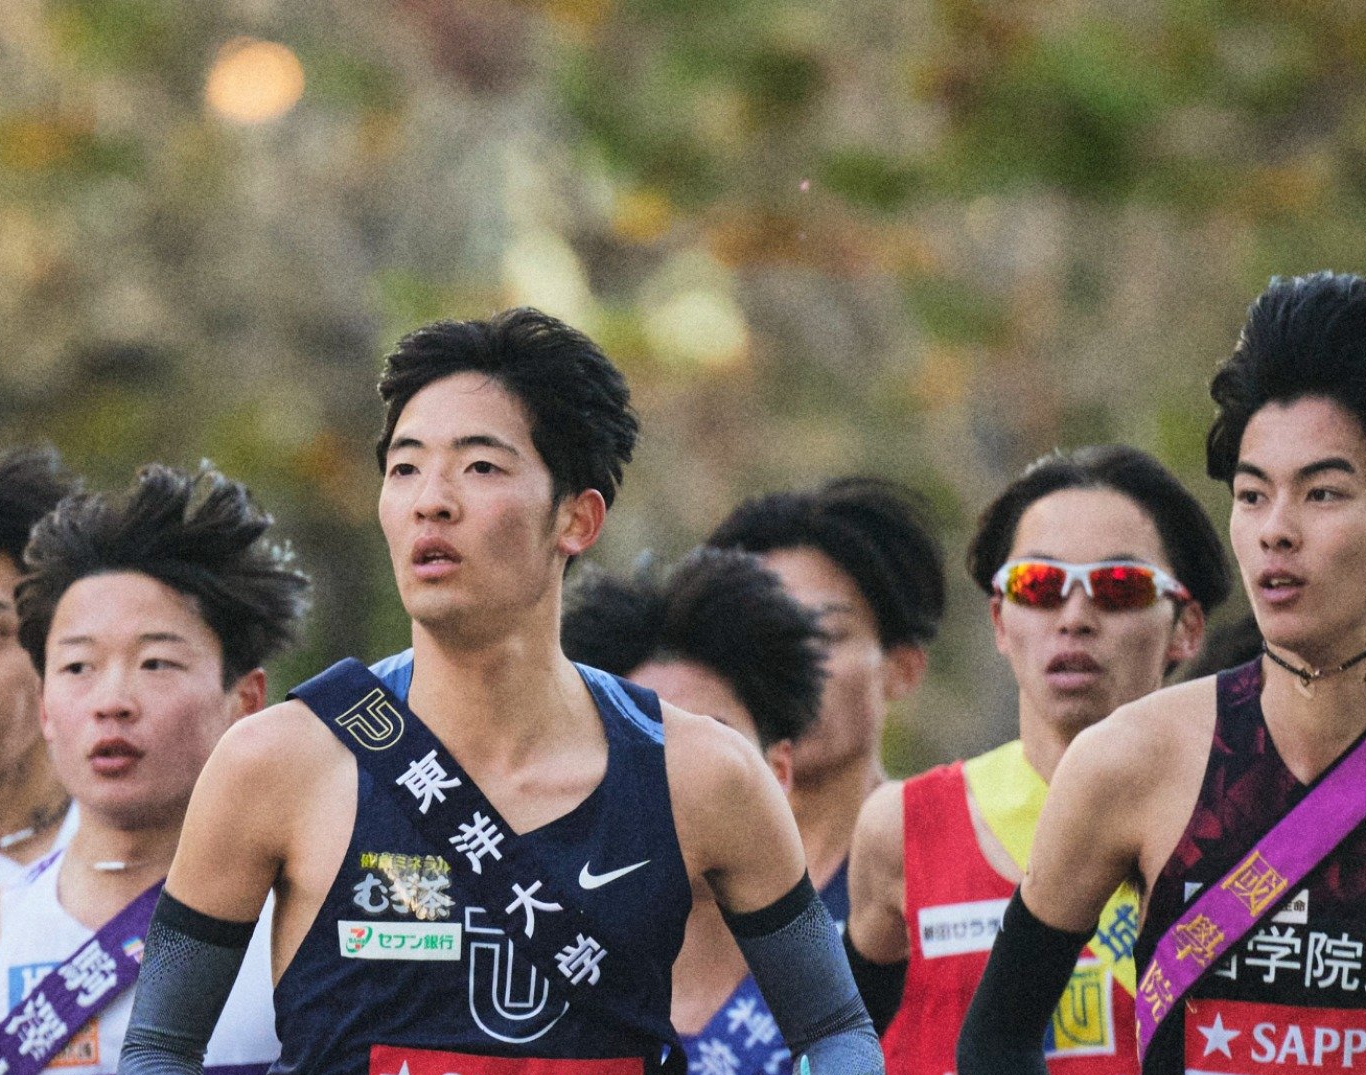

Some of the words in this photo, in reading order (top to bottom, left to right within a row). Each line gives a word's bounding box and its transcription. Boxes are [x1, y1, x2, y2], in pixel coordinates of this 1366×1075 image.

[395, 749, 607, 986] 東洋大学
[354, 873, 456, 920] むぎ茶
[378, 932, 454, 950] セブン銀行
